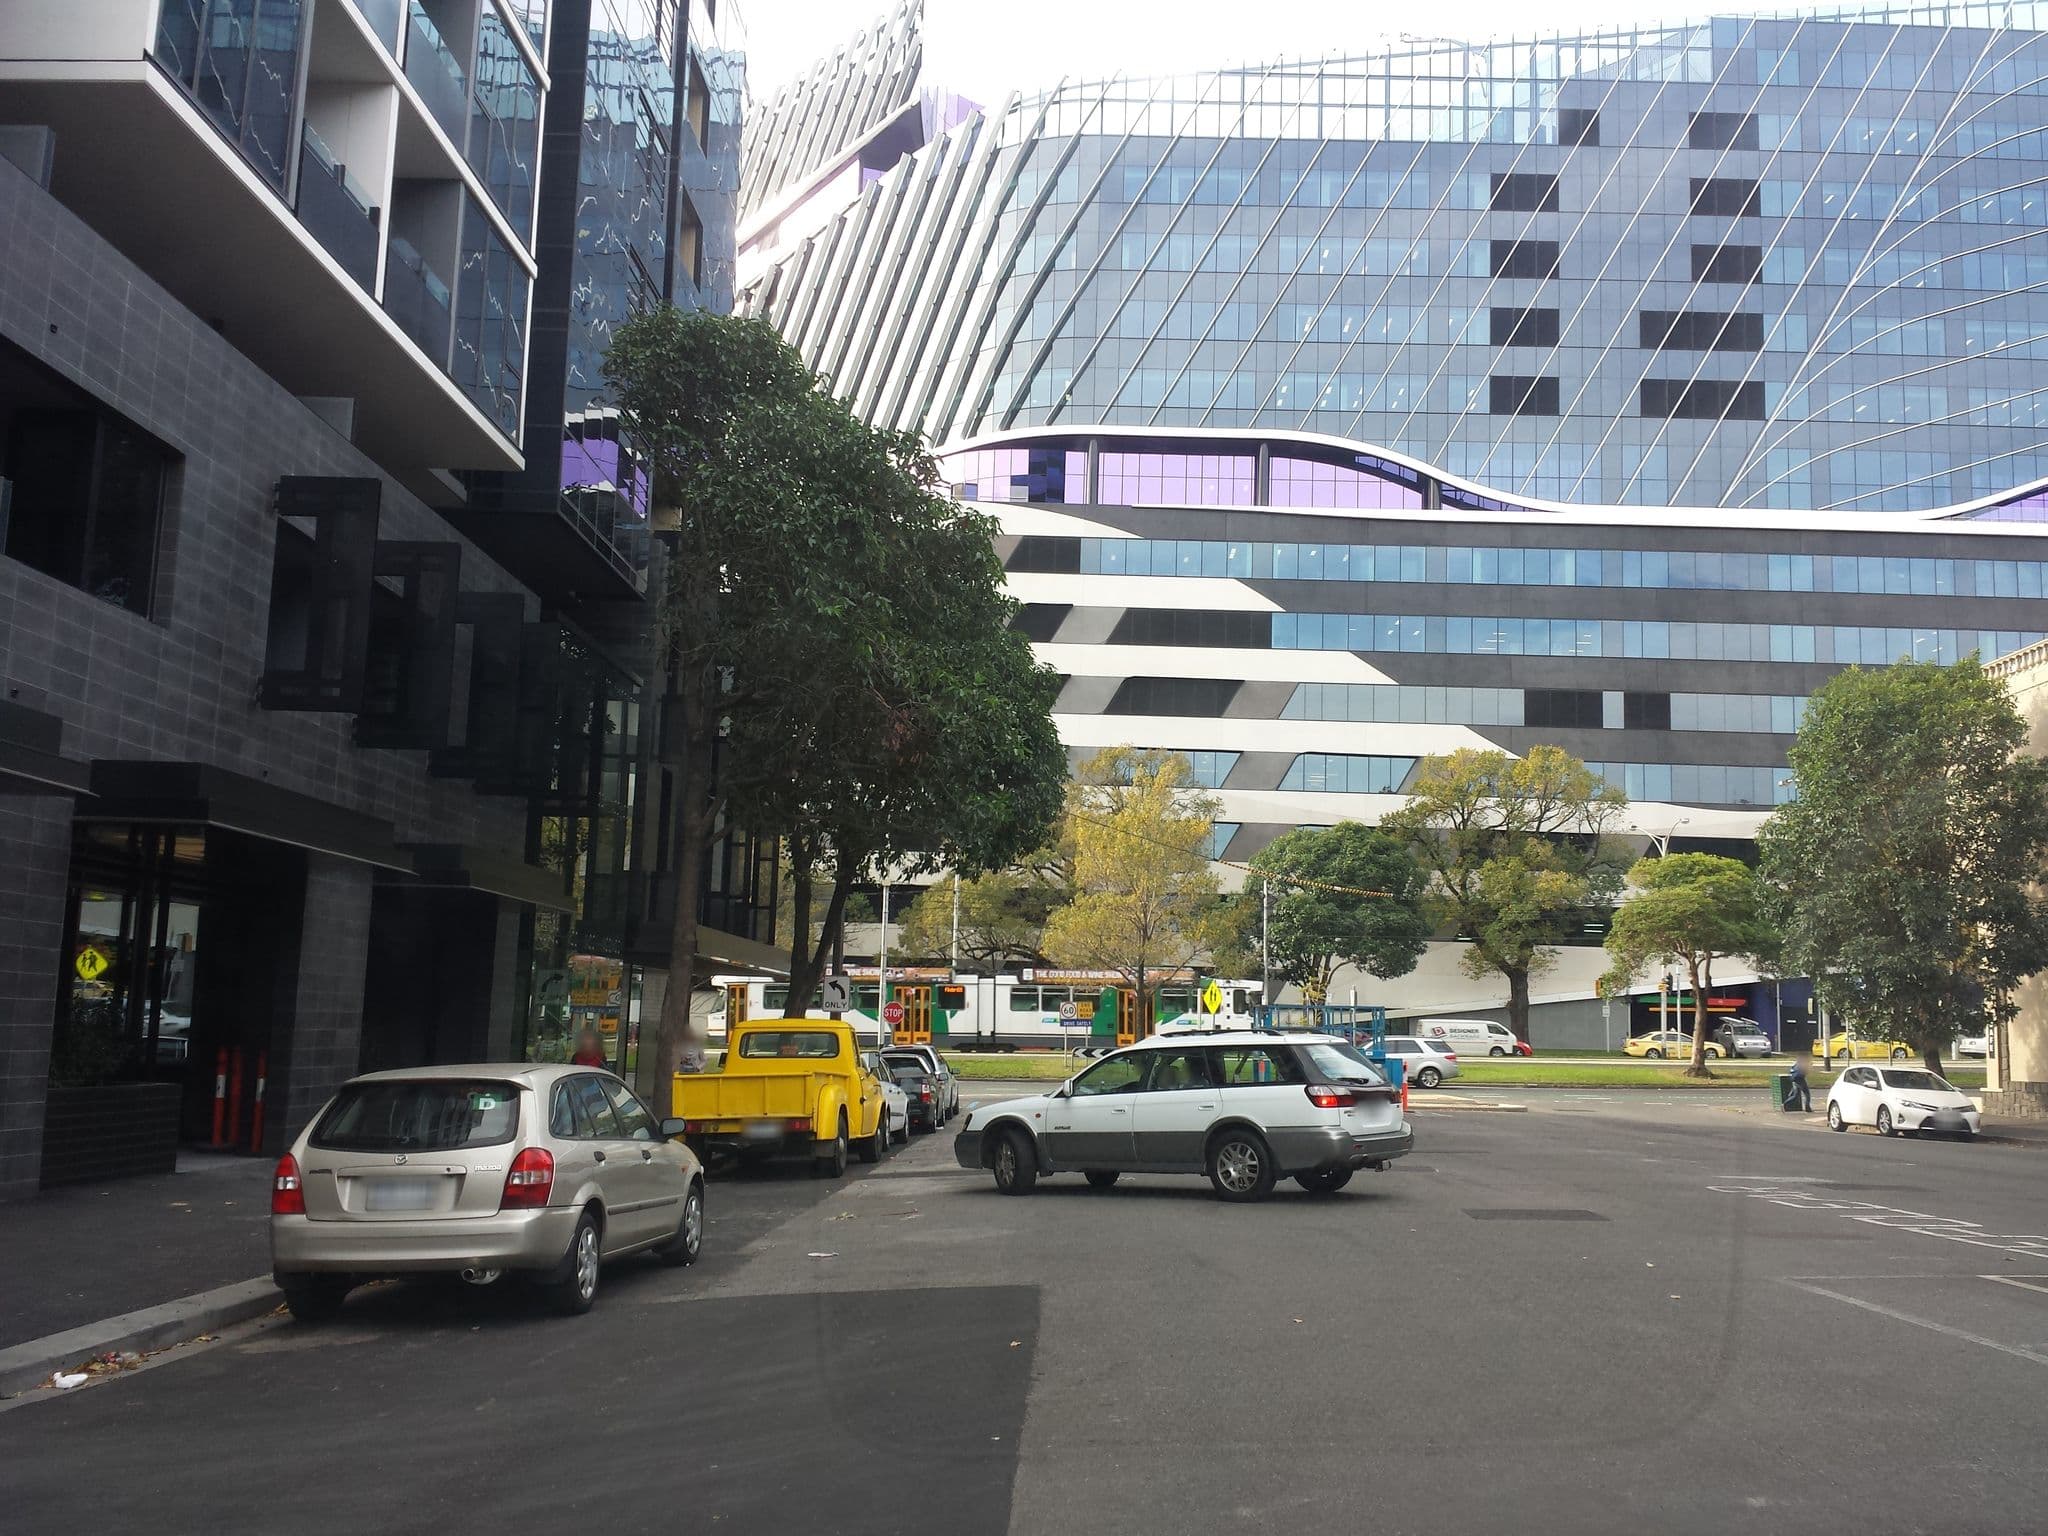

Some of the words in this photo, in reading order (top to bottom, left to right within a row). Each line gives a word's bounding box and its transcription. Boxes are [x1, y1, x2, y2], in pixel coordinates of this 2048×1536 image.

[1036, 970, 1048, 978] THE
[884, 1008, 903, 1017] STOP
[1063, 1006, 1074, 1015] 60
